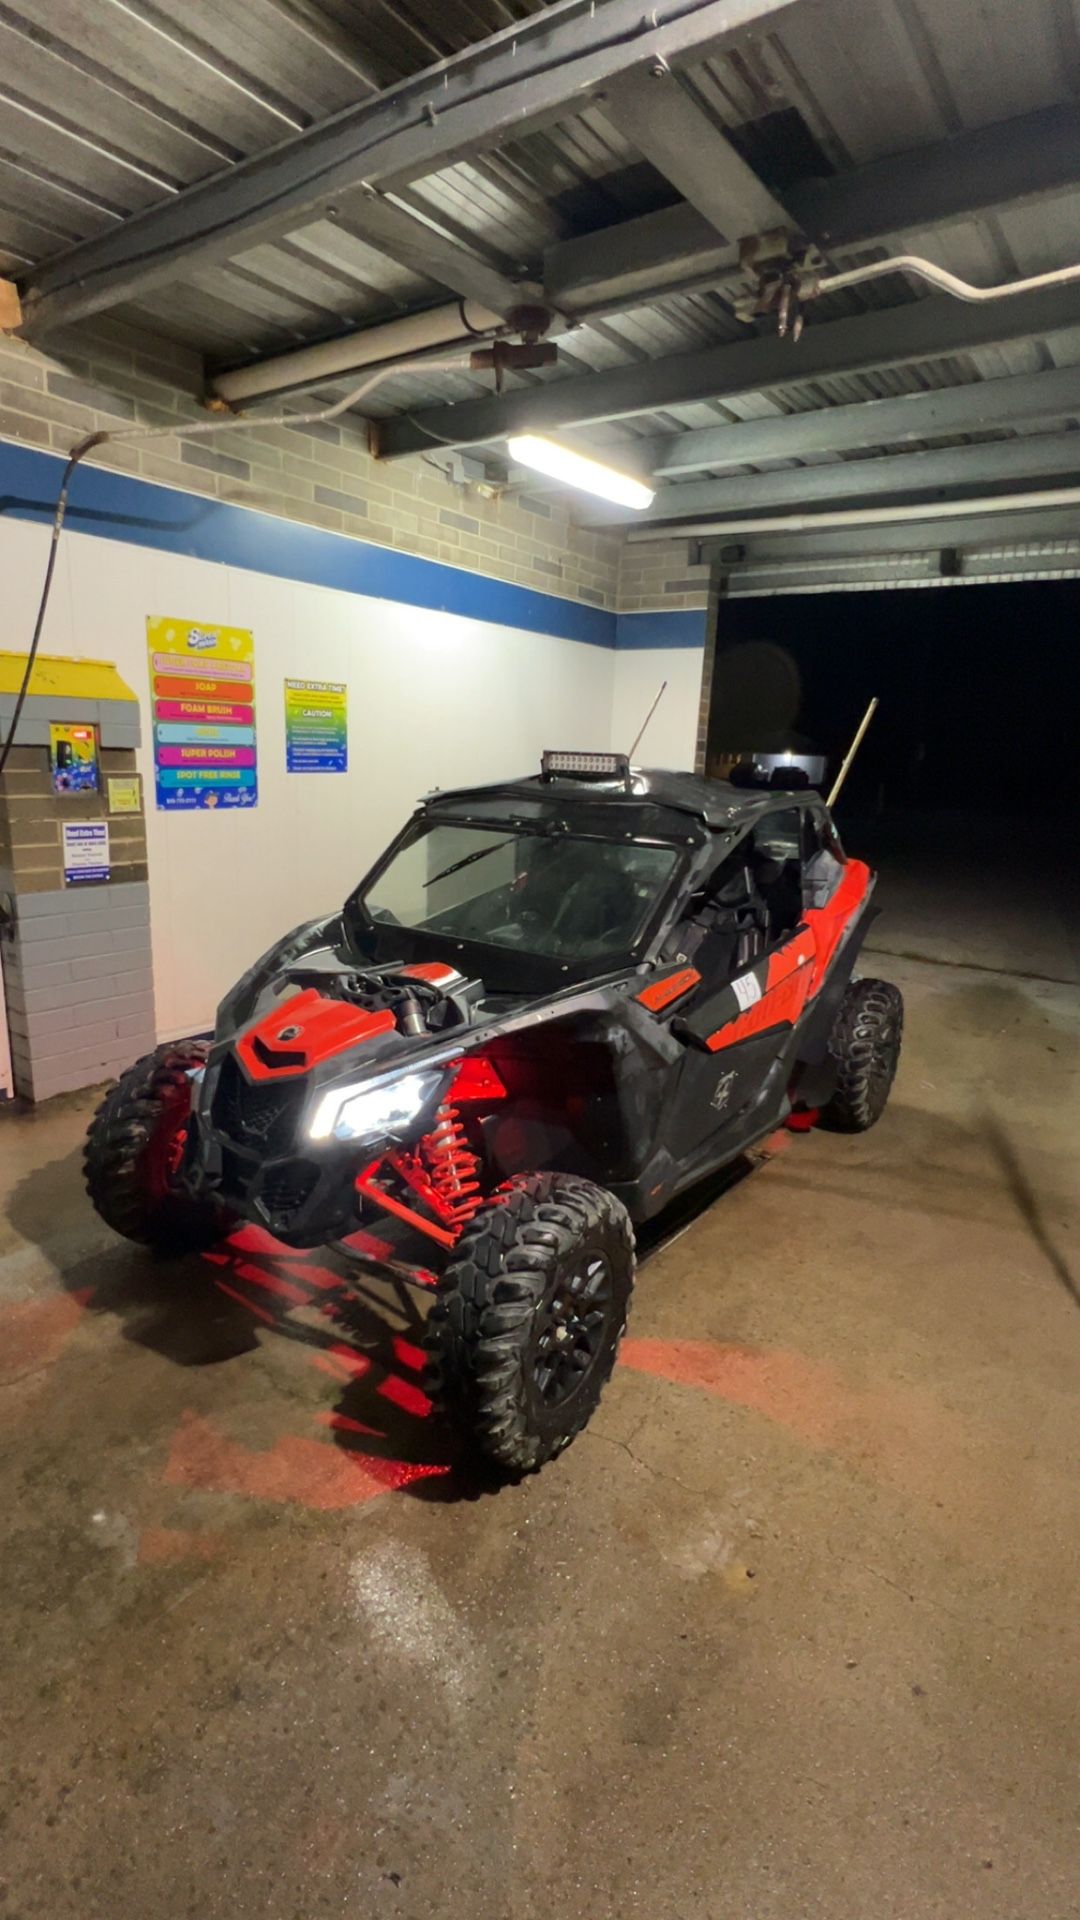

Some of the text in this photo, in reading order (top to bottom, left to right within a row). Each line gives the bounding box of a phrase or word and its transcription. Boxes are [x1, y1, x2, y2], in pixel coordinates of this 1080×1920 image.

[195, 681, 217, 692] SOAP
[180, 703, 233, 715] FOAM BRUSH
[181, 748, 236, 759] SUPER POLISH
[176, 770, 197, 780] SPOT
